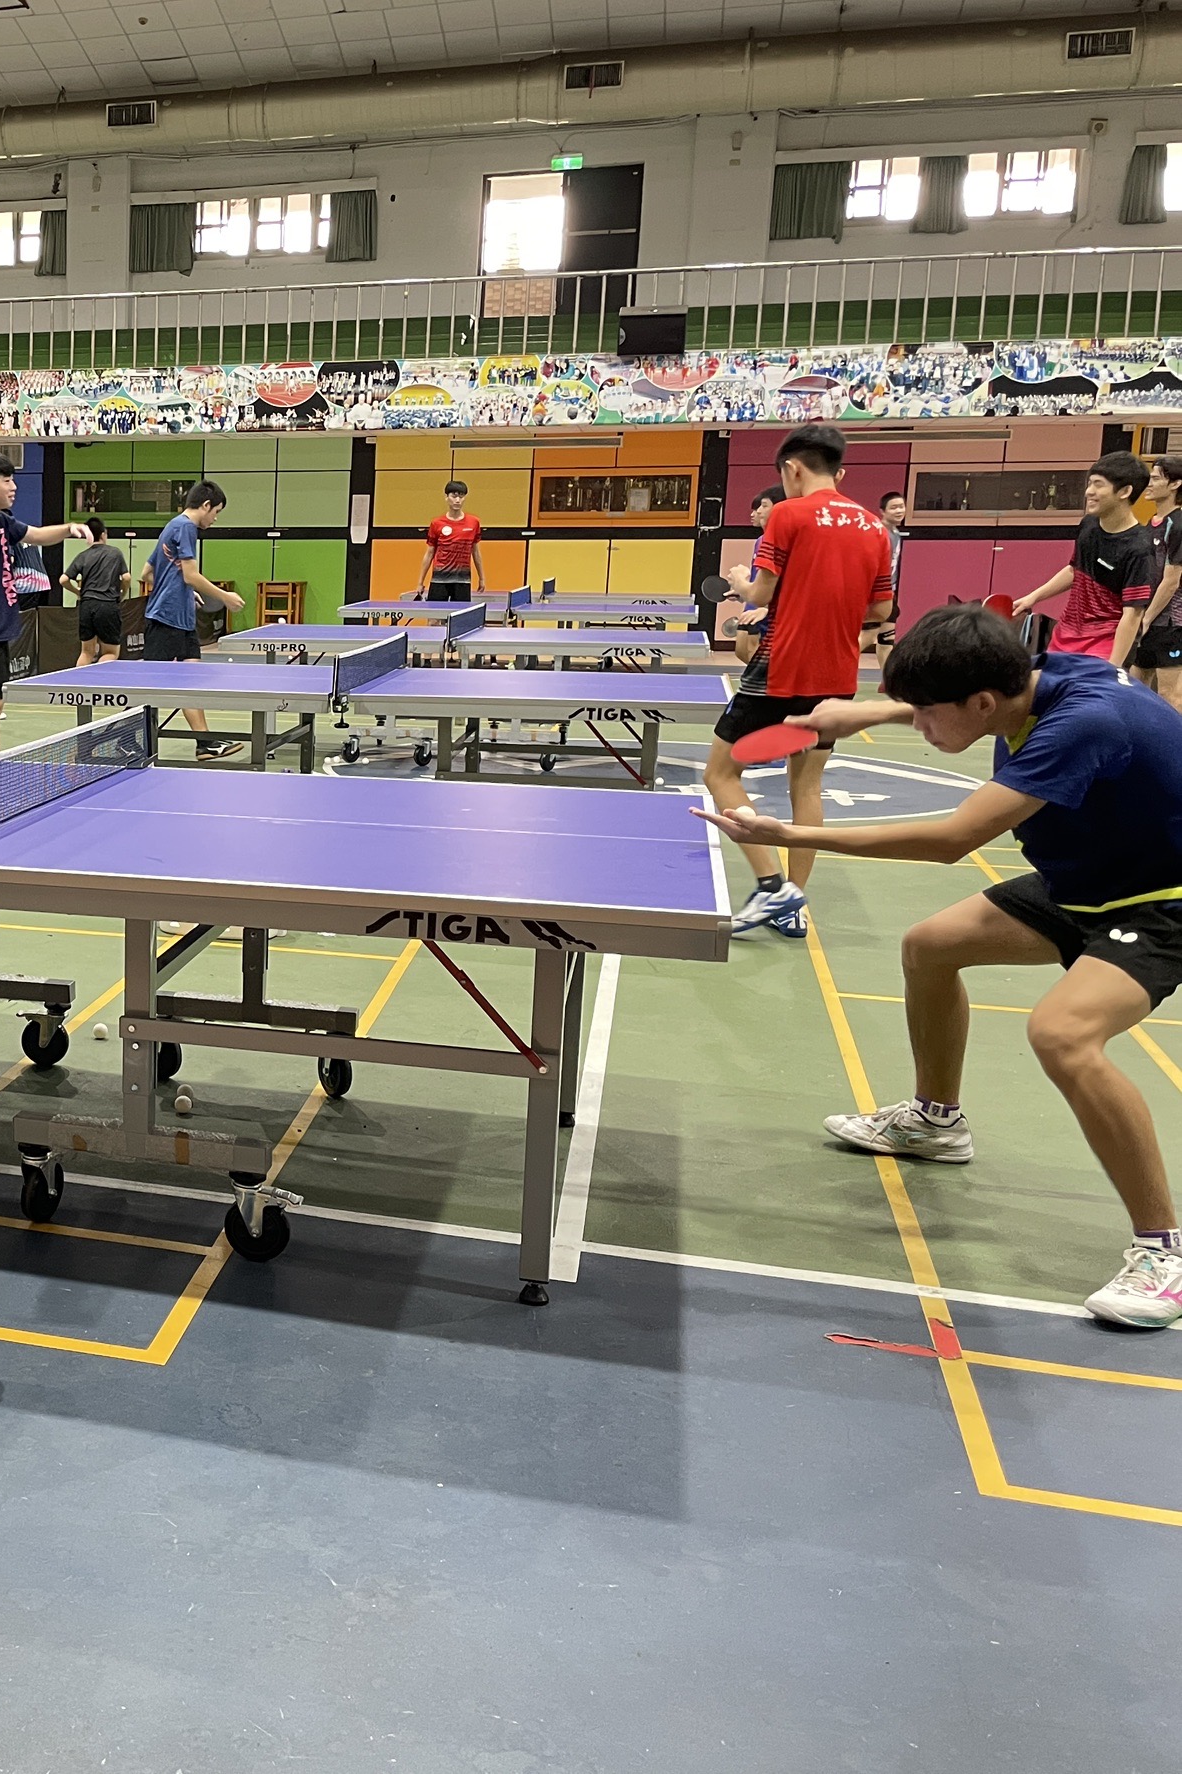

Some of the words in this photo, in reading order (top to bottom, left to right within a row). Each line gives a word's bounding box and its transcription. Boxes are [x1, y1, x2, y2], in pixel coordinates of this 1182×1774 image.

[360, 610, 405, 621] 7190-PRO
[620, 615, 653, 623] STIGA
[250, 641, 307, 654] 7190-PRO
[602, 647, 646, 657] STIGA
[47, 691, 130, 708] 7190-PRO
[568, 706, 636, 724] STIGA
[365, 909, 510, 945] STIGA
